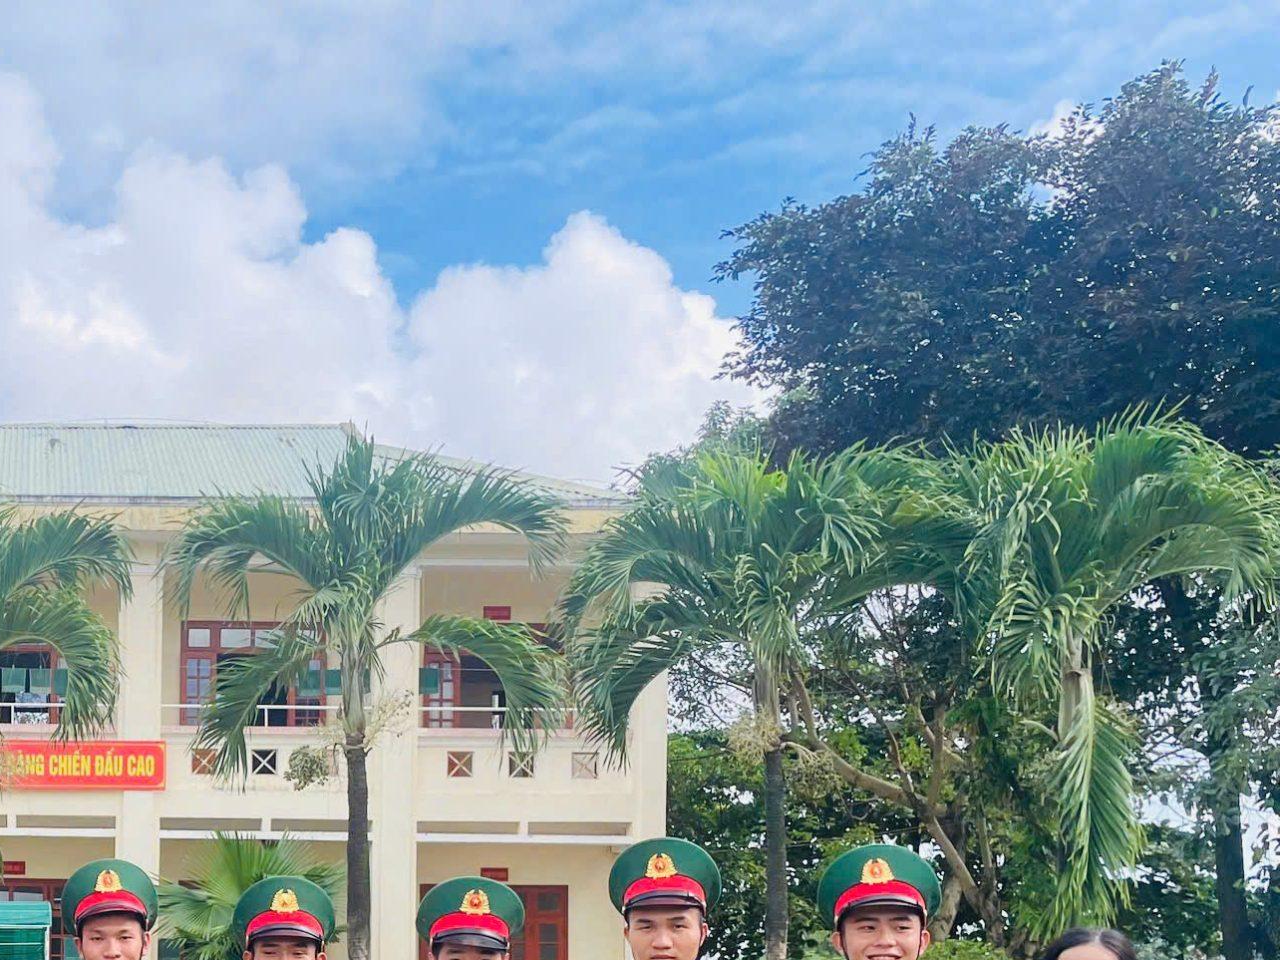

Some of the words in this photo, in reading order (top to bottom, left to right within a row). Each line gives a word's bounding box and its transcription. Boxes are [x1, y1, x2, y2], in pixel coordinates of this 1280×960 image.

[49, 748, 91, 777] CHIẾN
[95, 747, 123, 777] ĐẤU
[127, 754, 155, 777] CAO
